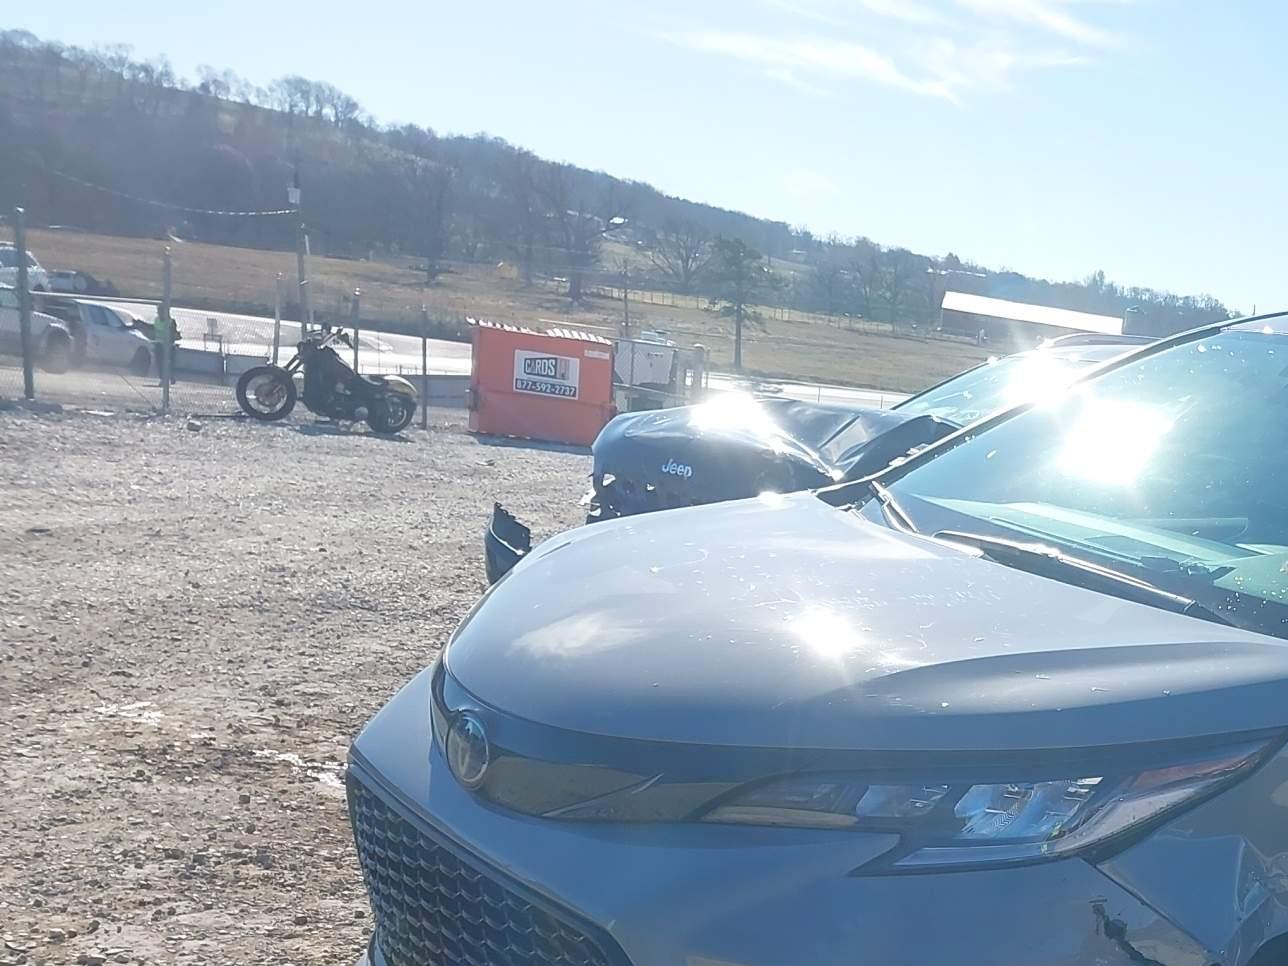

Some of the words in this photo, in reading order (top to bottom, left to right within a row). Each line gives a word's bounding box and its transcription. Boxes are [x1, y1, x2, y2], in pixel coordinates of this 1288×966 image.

[525, 359, 557, 376] CARDS
[516, 379, 576, 397] 877-592-2737
[662, 458, 693, 480] Jeep
